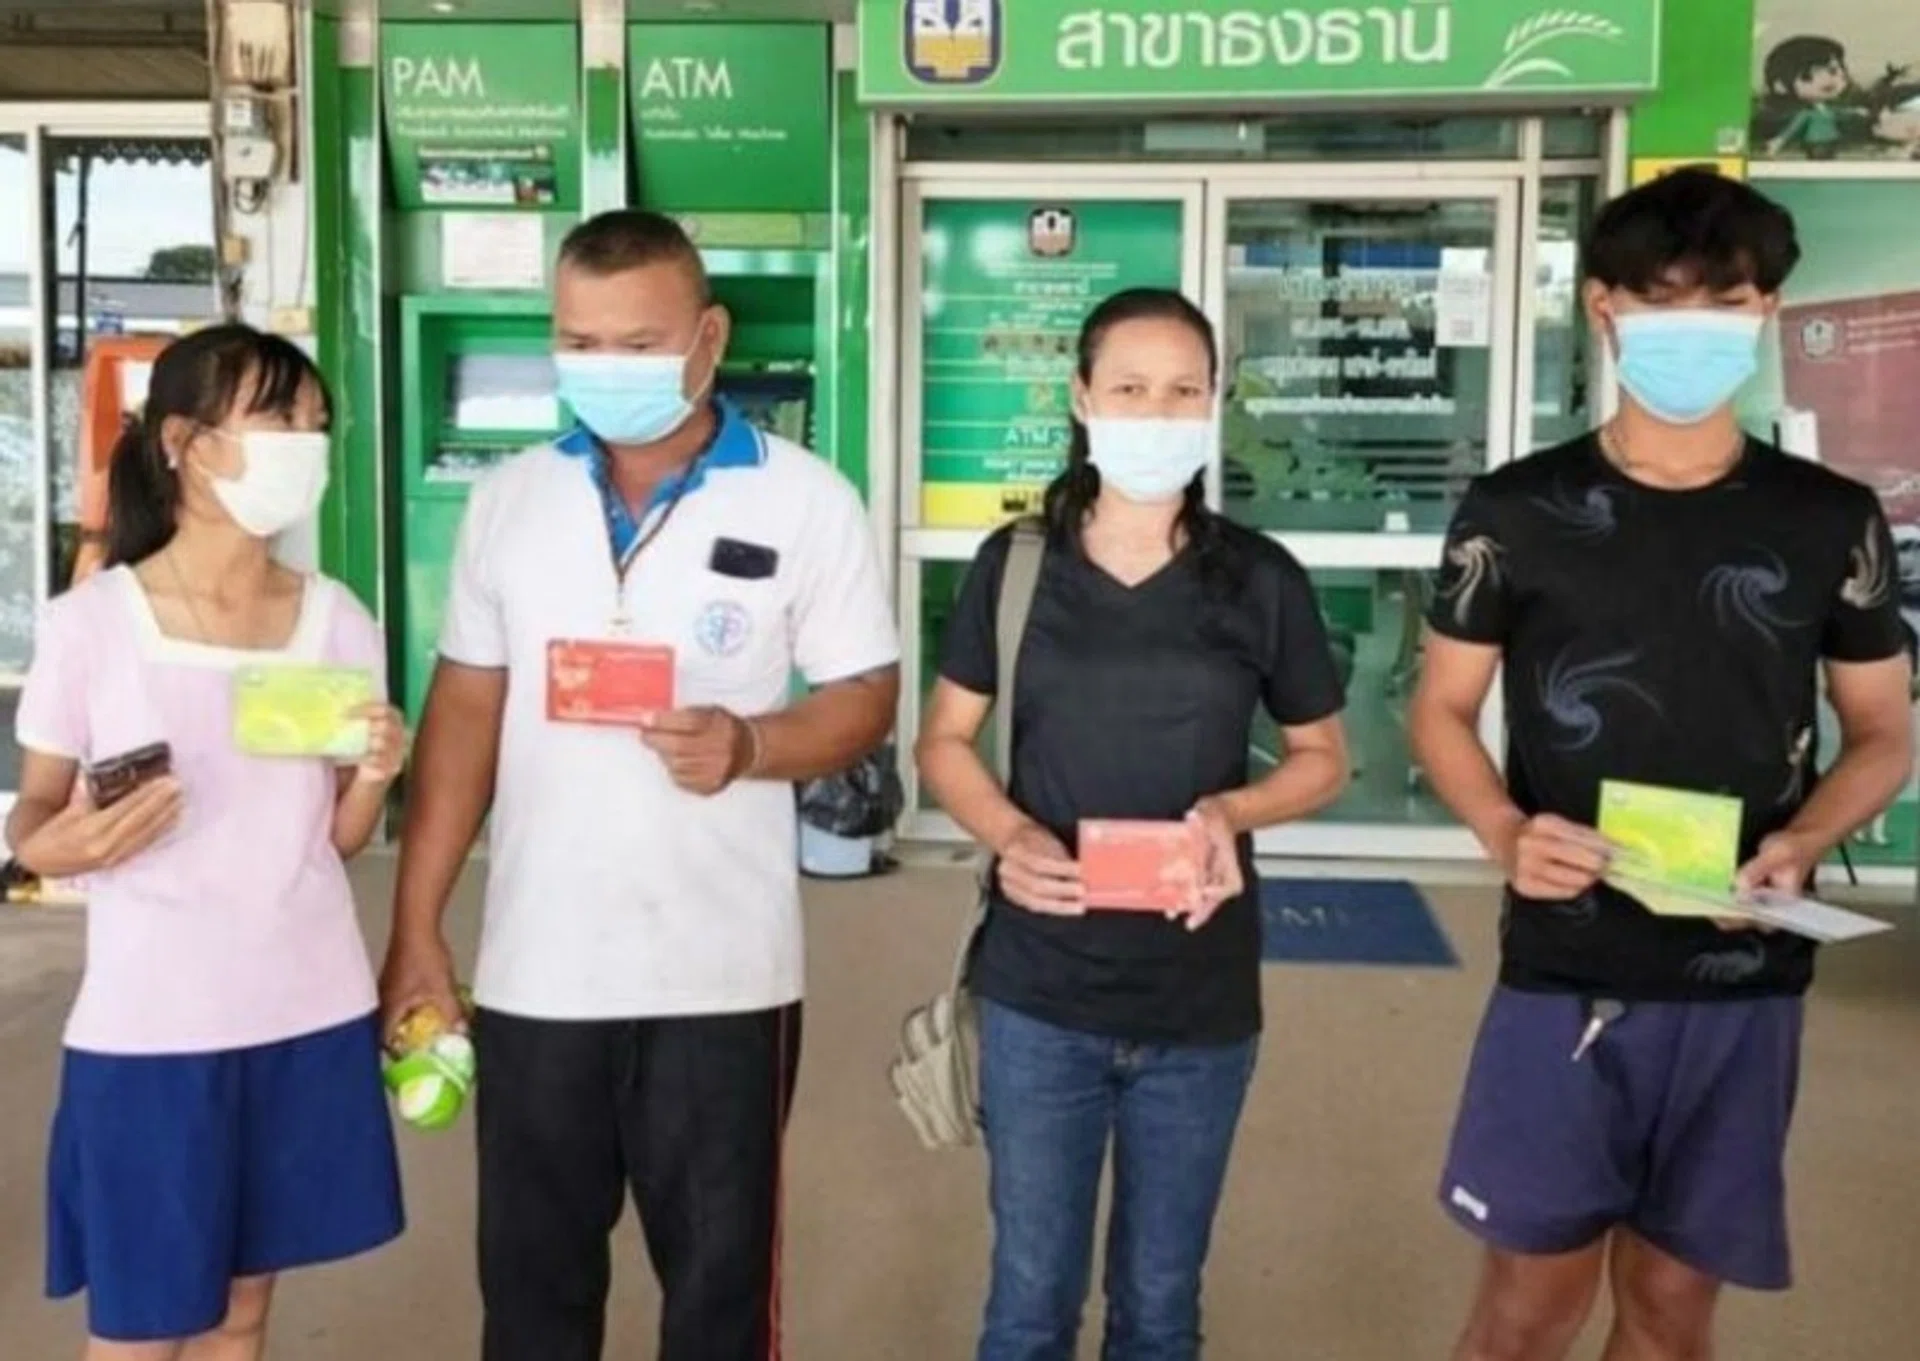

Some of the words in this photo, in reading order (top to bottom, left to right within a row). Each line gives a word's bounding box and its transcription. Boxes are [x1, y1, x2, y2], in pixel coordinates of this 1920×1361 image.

[1056, 0, 1452, 69] สาขาธงธาน
[392, 56, 485, 98] PAM
[640, 56, 734, 99] ATM
